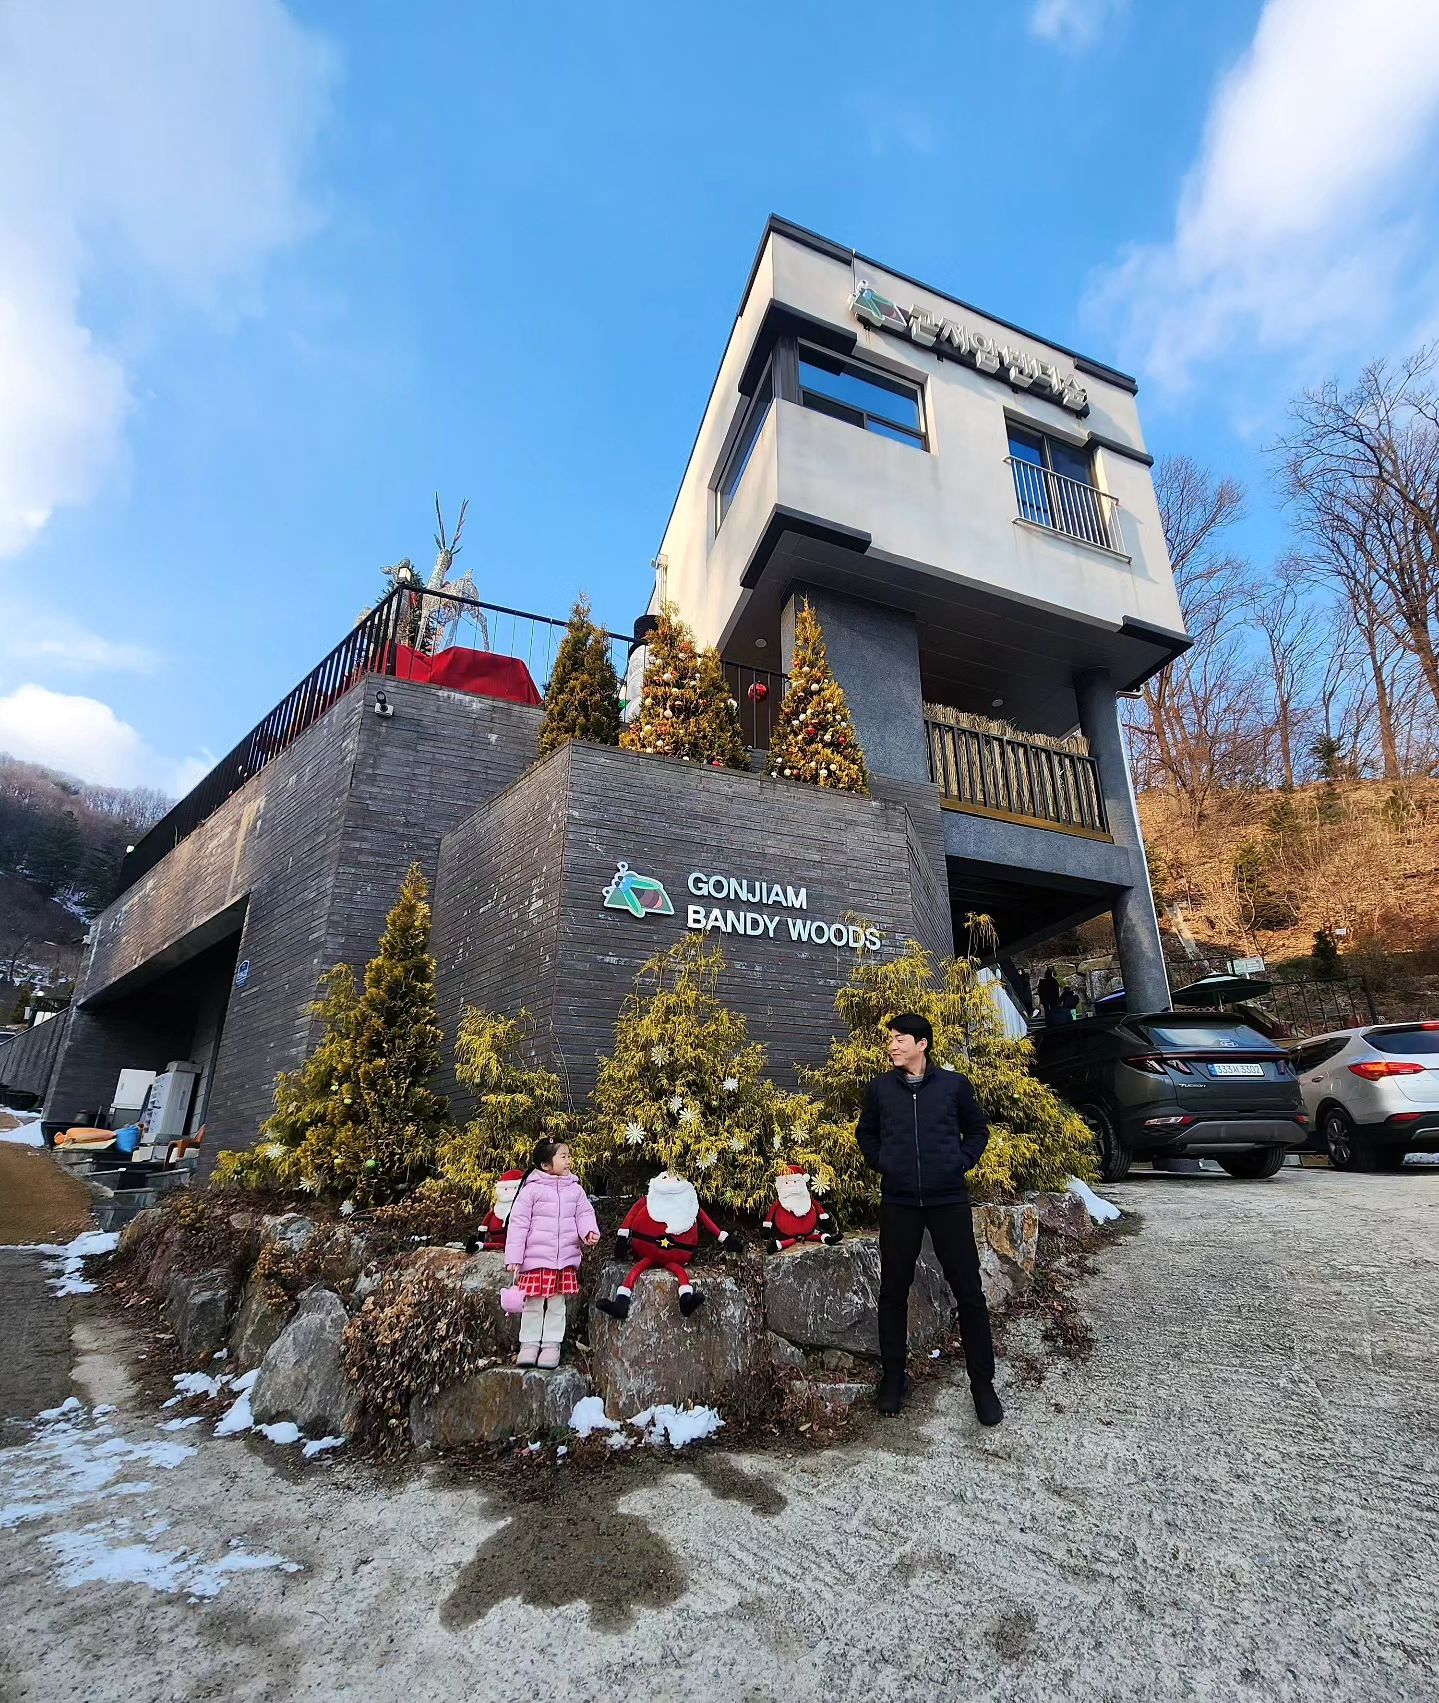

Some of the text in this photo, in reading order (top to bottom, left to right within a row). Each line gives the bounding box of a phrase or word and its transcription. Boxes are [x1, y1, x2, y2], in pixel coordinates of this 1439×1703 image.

[687, 872, 808, 910] GONJIAM
[686, 904, 882, 951] BANDY WOODS
